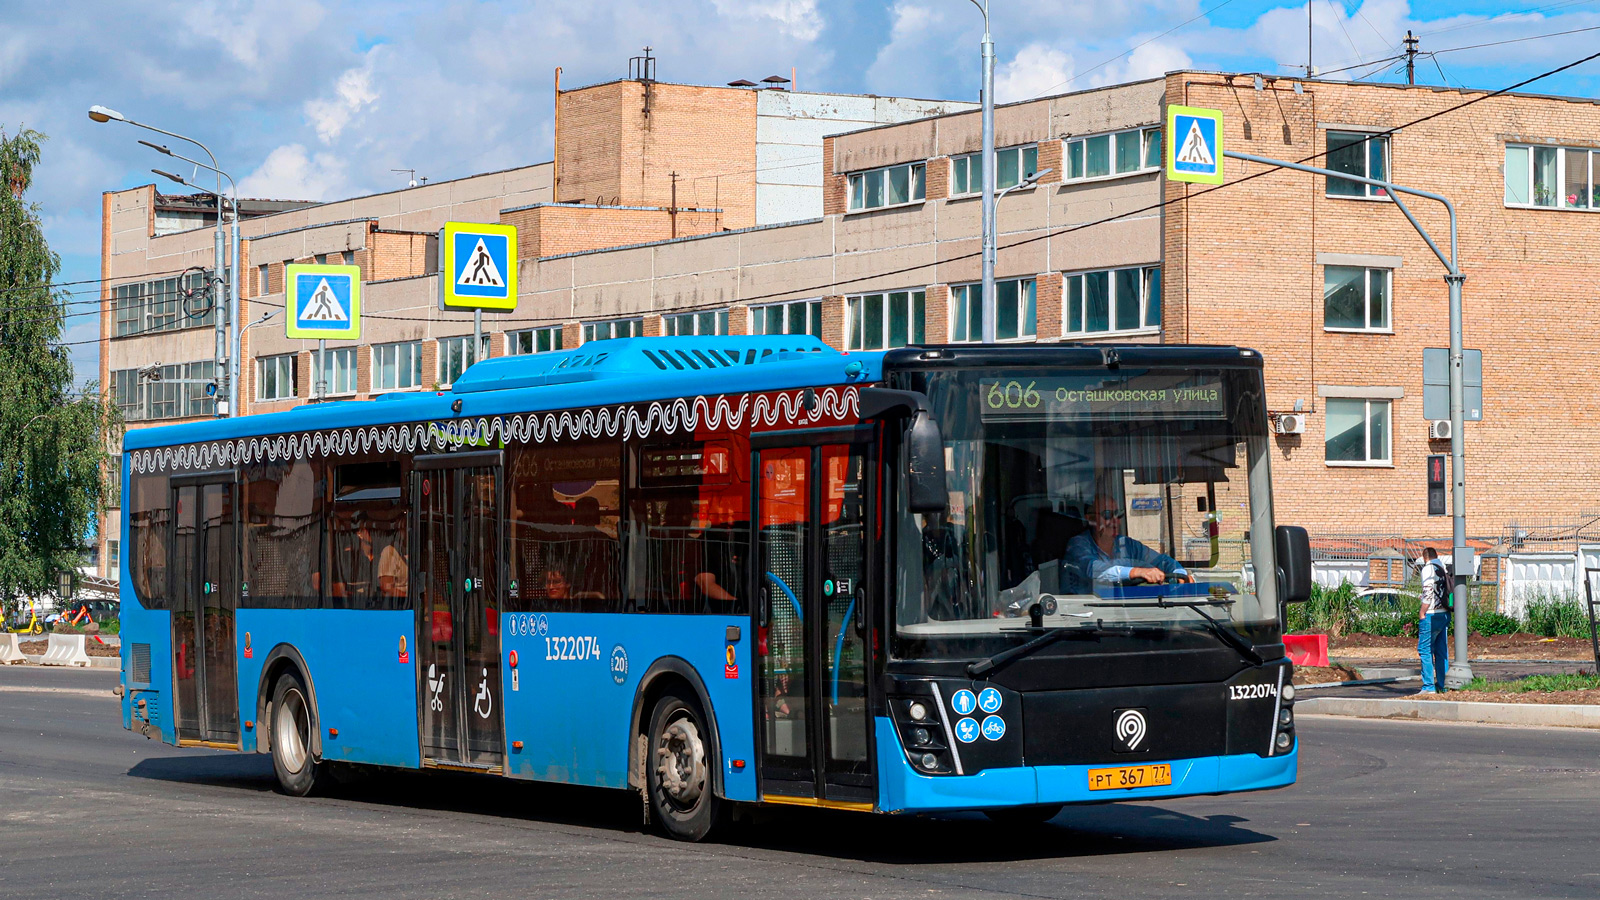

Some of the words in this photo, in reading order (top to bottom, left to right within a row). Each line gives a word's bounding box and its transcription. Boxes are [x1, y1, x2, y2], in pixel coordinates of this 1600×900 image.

[987, 380, 1041, 409] 606
[1055, 387, 1166, 403] Осташковская
[1173, 388, 1218, 404] улица
[545, 636, 600, 661] 1322074
[614, 656, 625, 672] 20
[1229, 683, 1277, 700] 1322074
[1119, 769, 1144, 785] 367
[1152, 766, 1166, 778] 77
